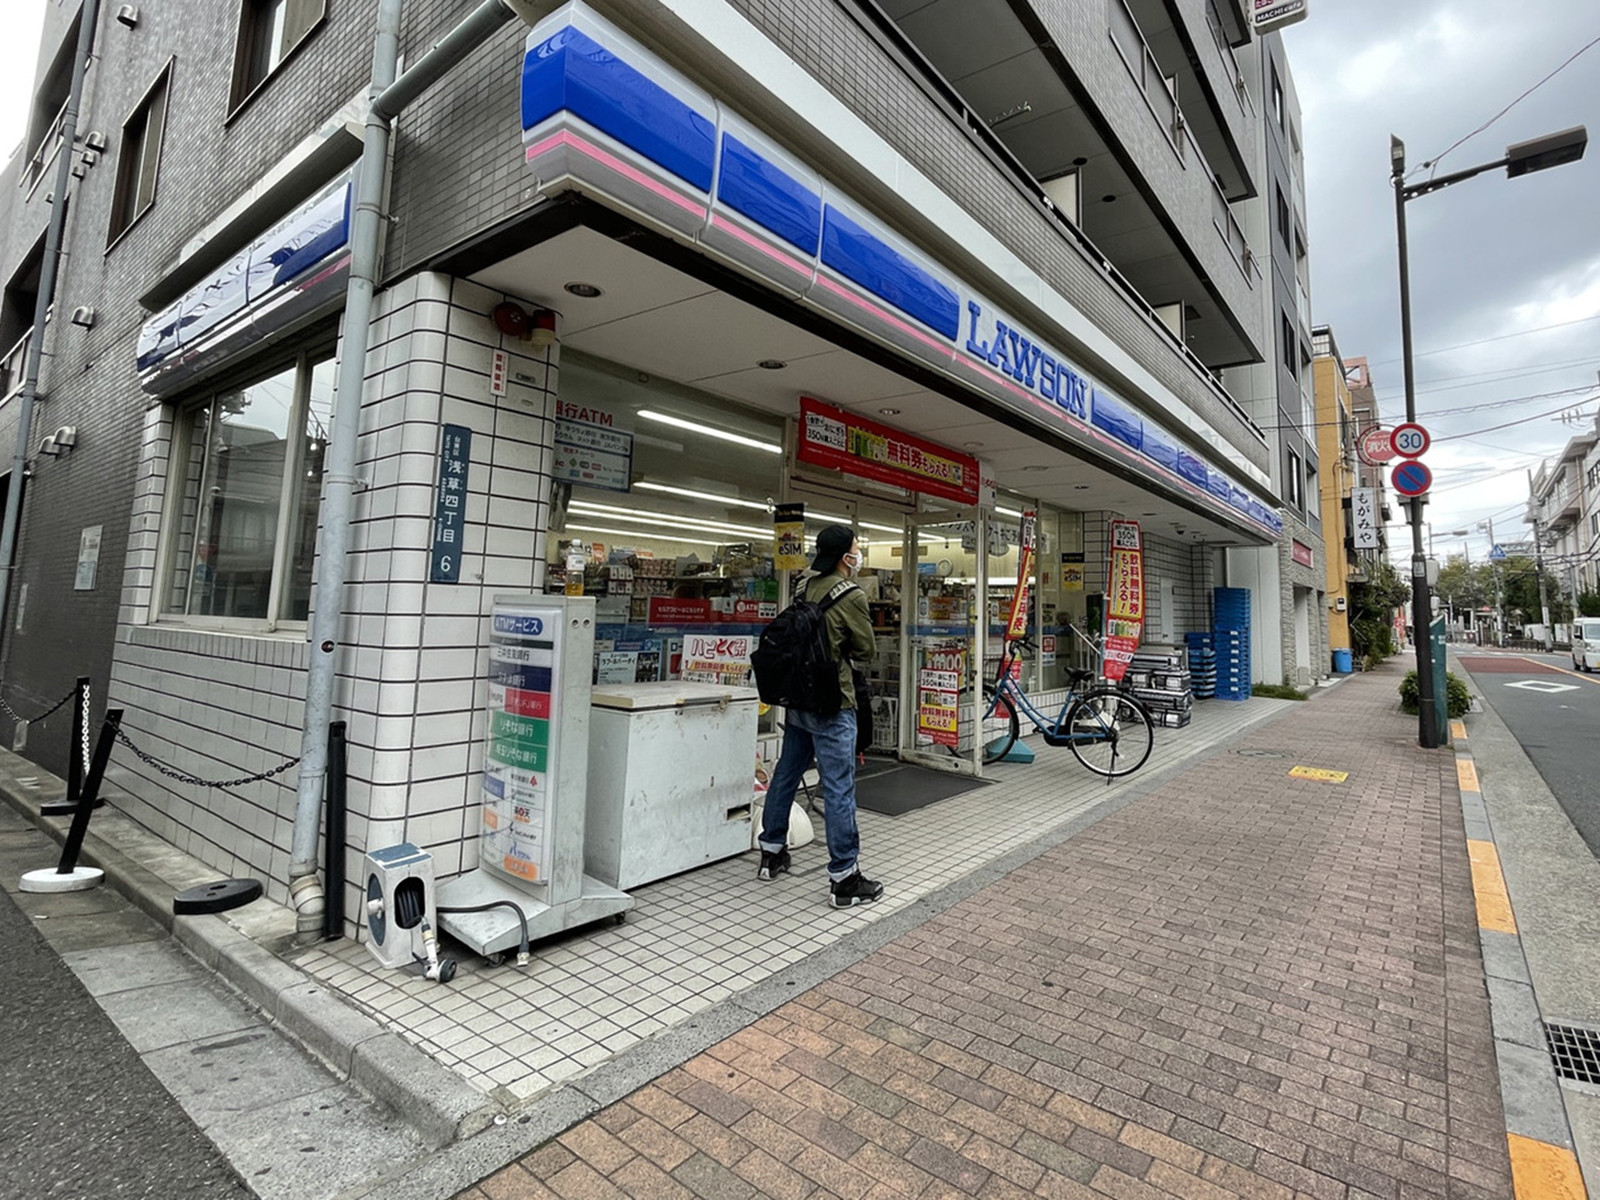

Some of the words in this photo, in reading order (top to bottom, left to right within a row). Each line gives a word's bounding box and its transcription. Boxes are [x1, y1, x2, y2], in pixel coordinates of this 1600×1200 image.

[1256, 8, 1283, 21] MACHI
[966, 300, 1087, 420] LAWSON
[1399, 433, 1421, 449] 30
[443, 460, 462, 543] 浅草四丁目
[1358, 492, 1372, 543] もがみや
[779, 543, 802, 555] eSIM
[440, 555, 452, 572] 6
[1129, 553, 1140, 615] 飲料無料券
[495, 618, 540, 633] ATMサービス
